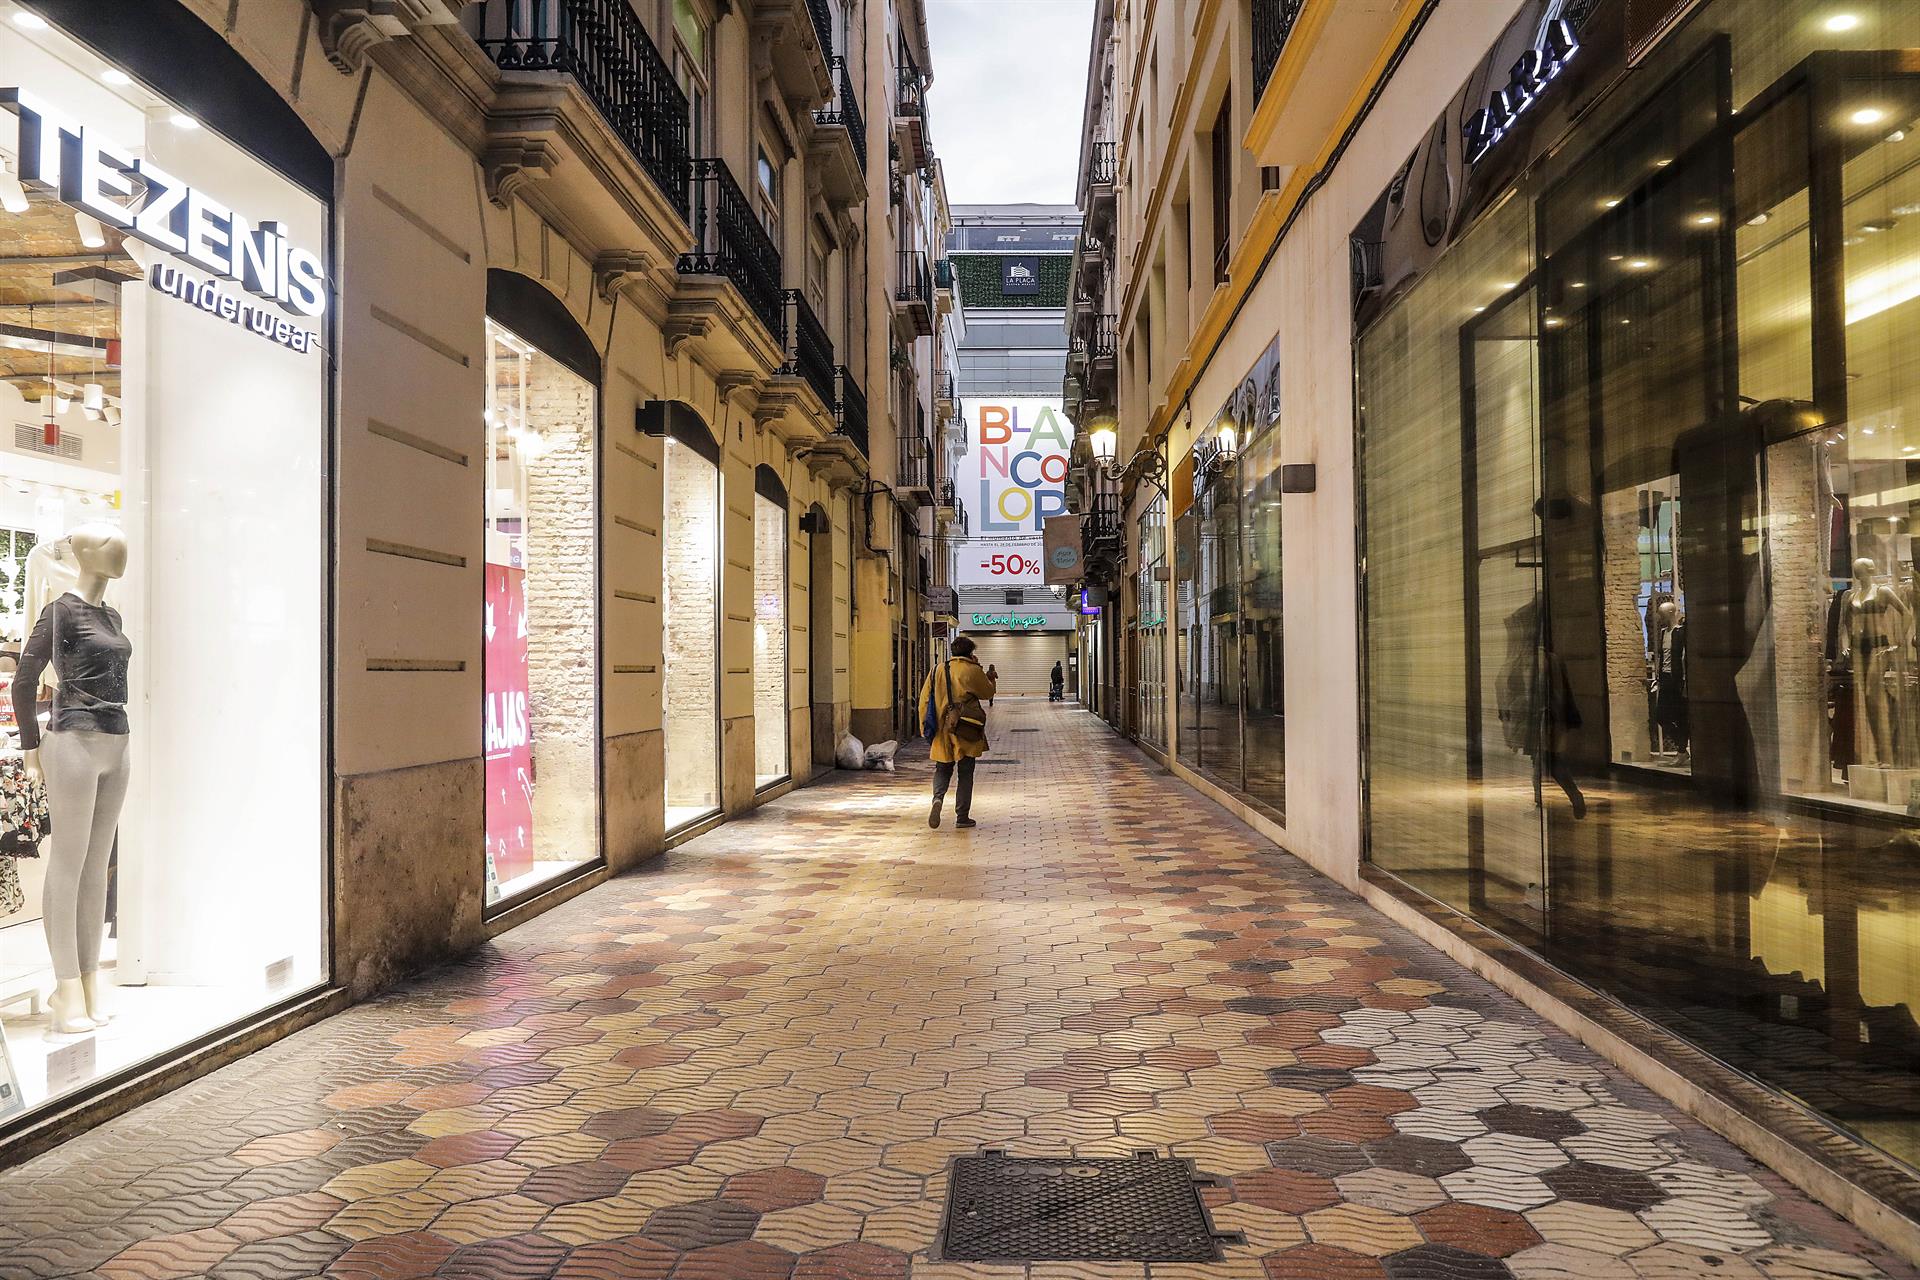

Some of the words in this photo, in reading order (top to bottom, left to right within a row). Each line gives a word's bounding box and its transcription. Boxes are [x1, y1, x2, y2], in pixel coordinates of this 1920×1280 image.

[1463, 20, 1579, 164] ZARA
[152, 263, 320, 352] underwear
[980, 406, 1069, 450] BLA
[980, 446, 1068, 489] NCO
[981, 554, 1040, 575] -50%
[972, 613, 982, 625] El
[984, 613, 1009, 625] Corte
[1009, 610, 1047, 629] Inglés
[486, 691, 526, 752] AJAS
